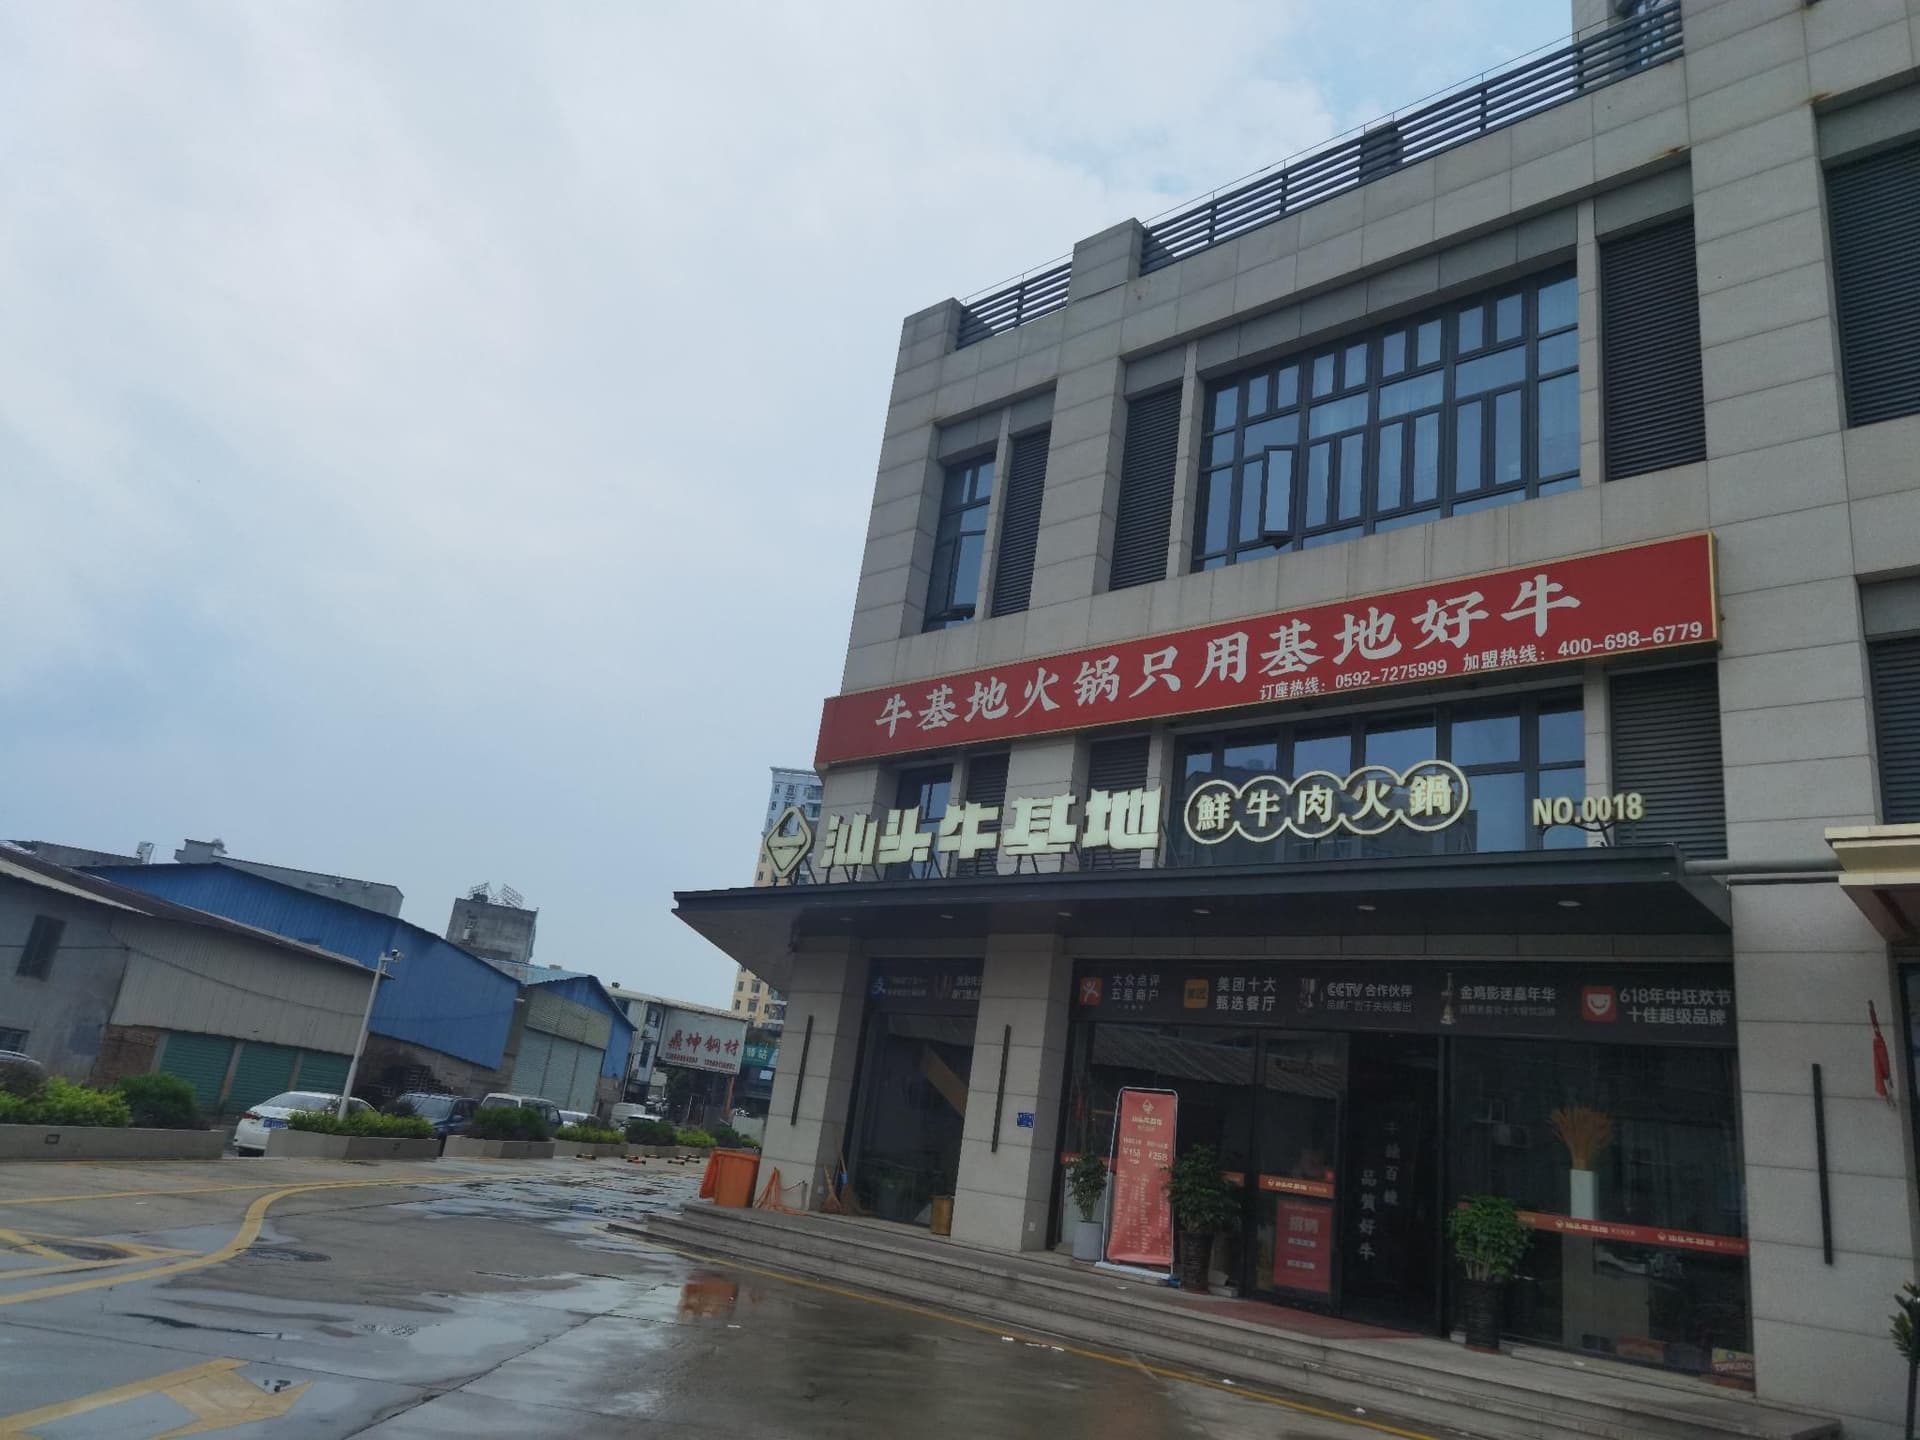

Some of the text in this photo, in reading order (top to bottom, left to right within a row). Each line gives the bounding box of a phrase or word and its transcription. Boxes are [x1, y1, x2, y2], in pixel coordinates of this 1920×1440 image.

[875, 573, 1581, 738] 牛基地火锅只用基地好牛
[1335, 659, 1447, 689] 0592-7275999
[1557, 621, 1703, 657] 400-698-6779
[1196, 775, 1453, 832] 鮮牛肉火鍋
[1532, 793, 1644, 825] NO.0018
[819, 786, 1163, 868] 汕头牛基地
[1216, 976, 1276, 993] 美团十大
[1619, 986, 1732, 1006] 618年中狂欢节
[1215, 995, 1276, 1012] 甄选餐厅
[1626, 1007, 1727, 1027] 十佳超级品牌
